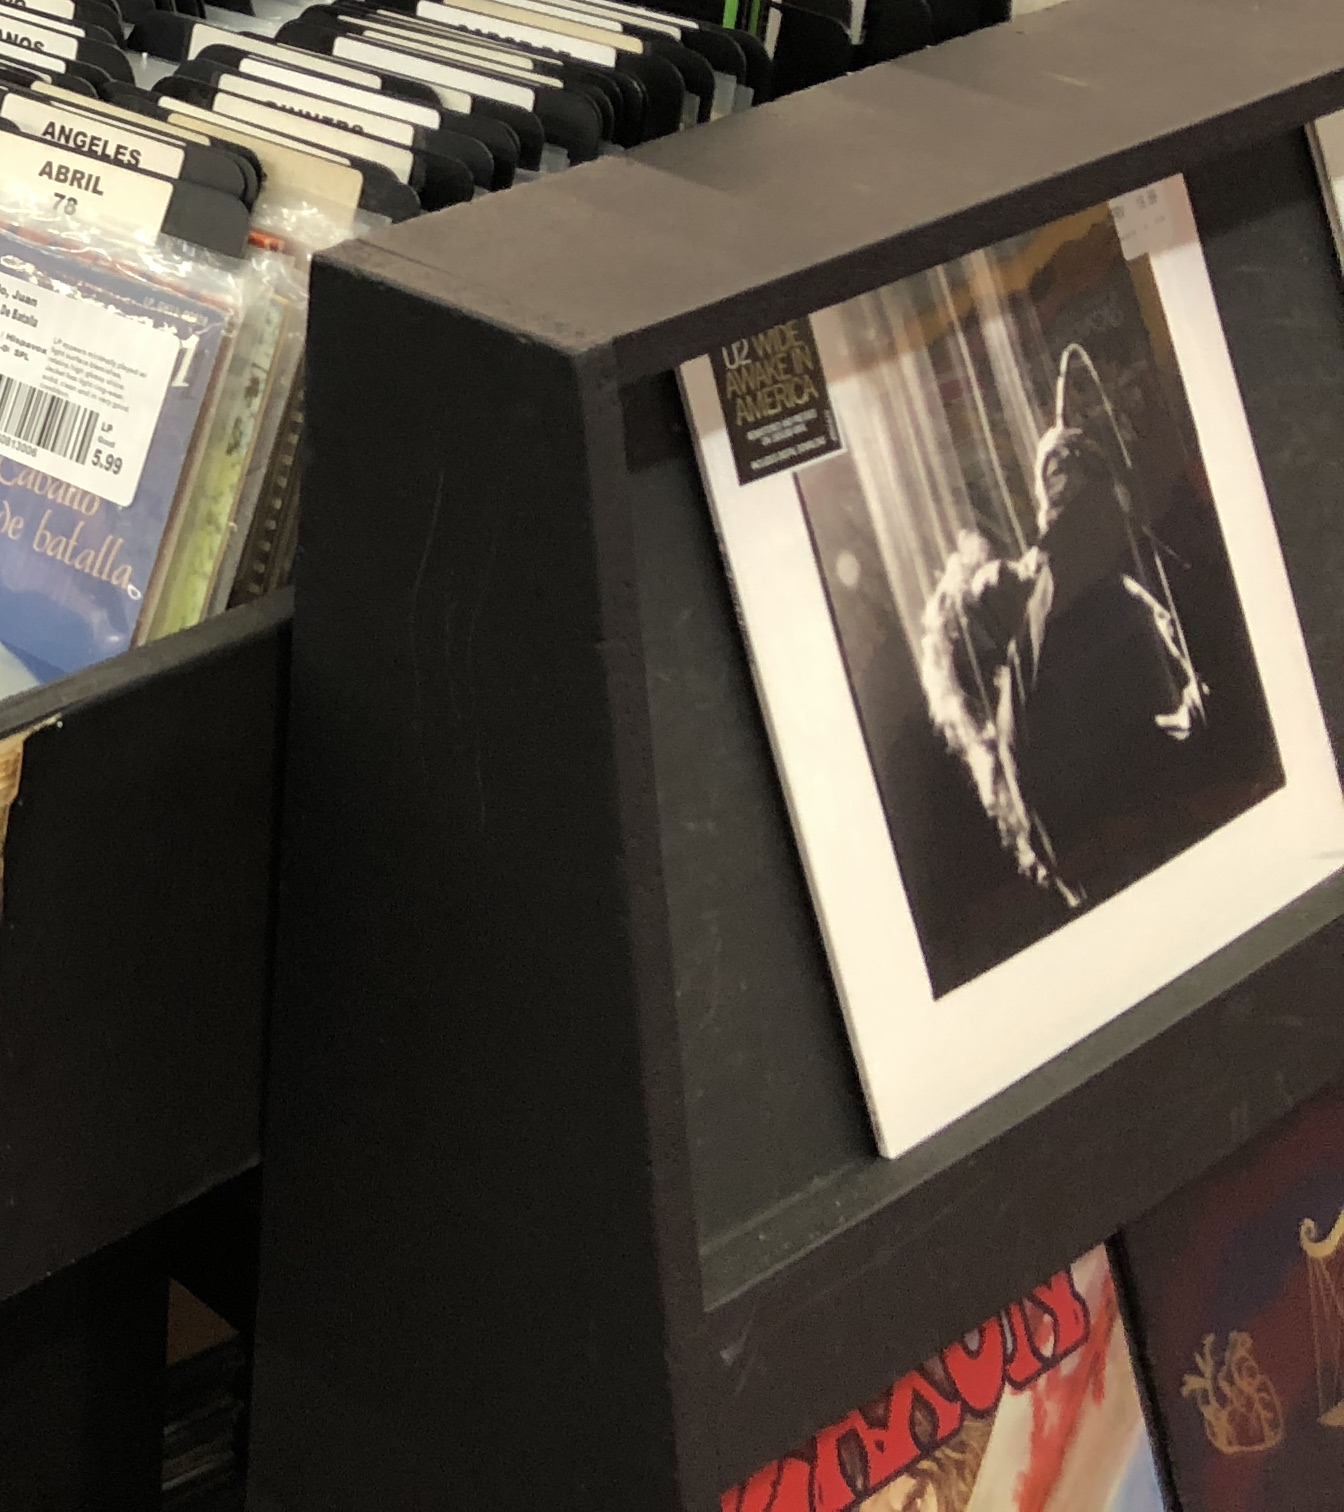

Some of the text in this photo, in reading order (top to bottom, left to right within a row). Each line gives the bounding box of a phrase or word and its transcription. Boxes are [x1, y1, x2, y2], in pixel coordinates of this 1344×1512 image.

[41, 120, 141, 167] ANGELES
[39, 159, 104, 197] ABRIL
[12, 289, 38, 307] Juan
[722, 319, 802, 370] U2 WIDE
[725, 347, 812, 398] AWAKE IN
[733, 375, 819, 424] AMERICA
[91, 448, 123, 475] 5.99
[33, 509, 132, 589] batalla
